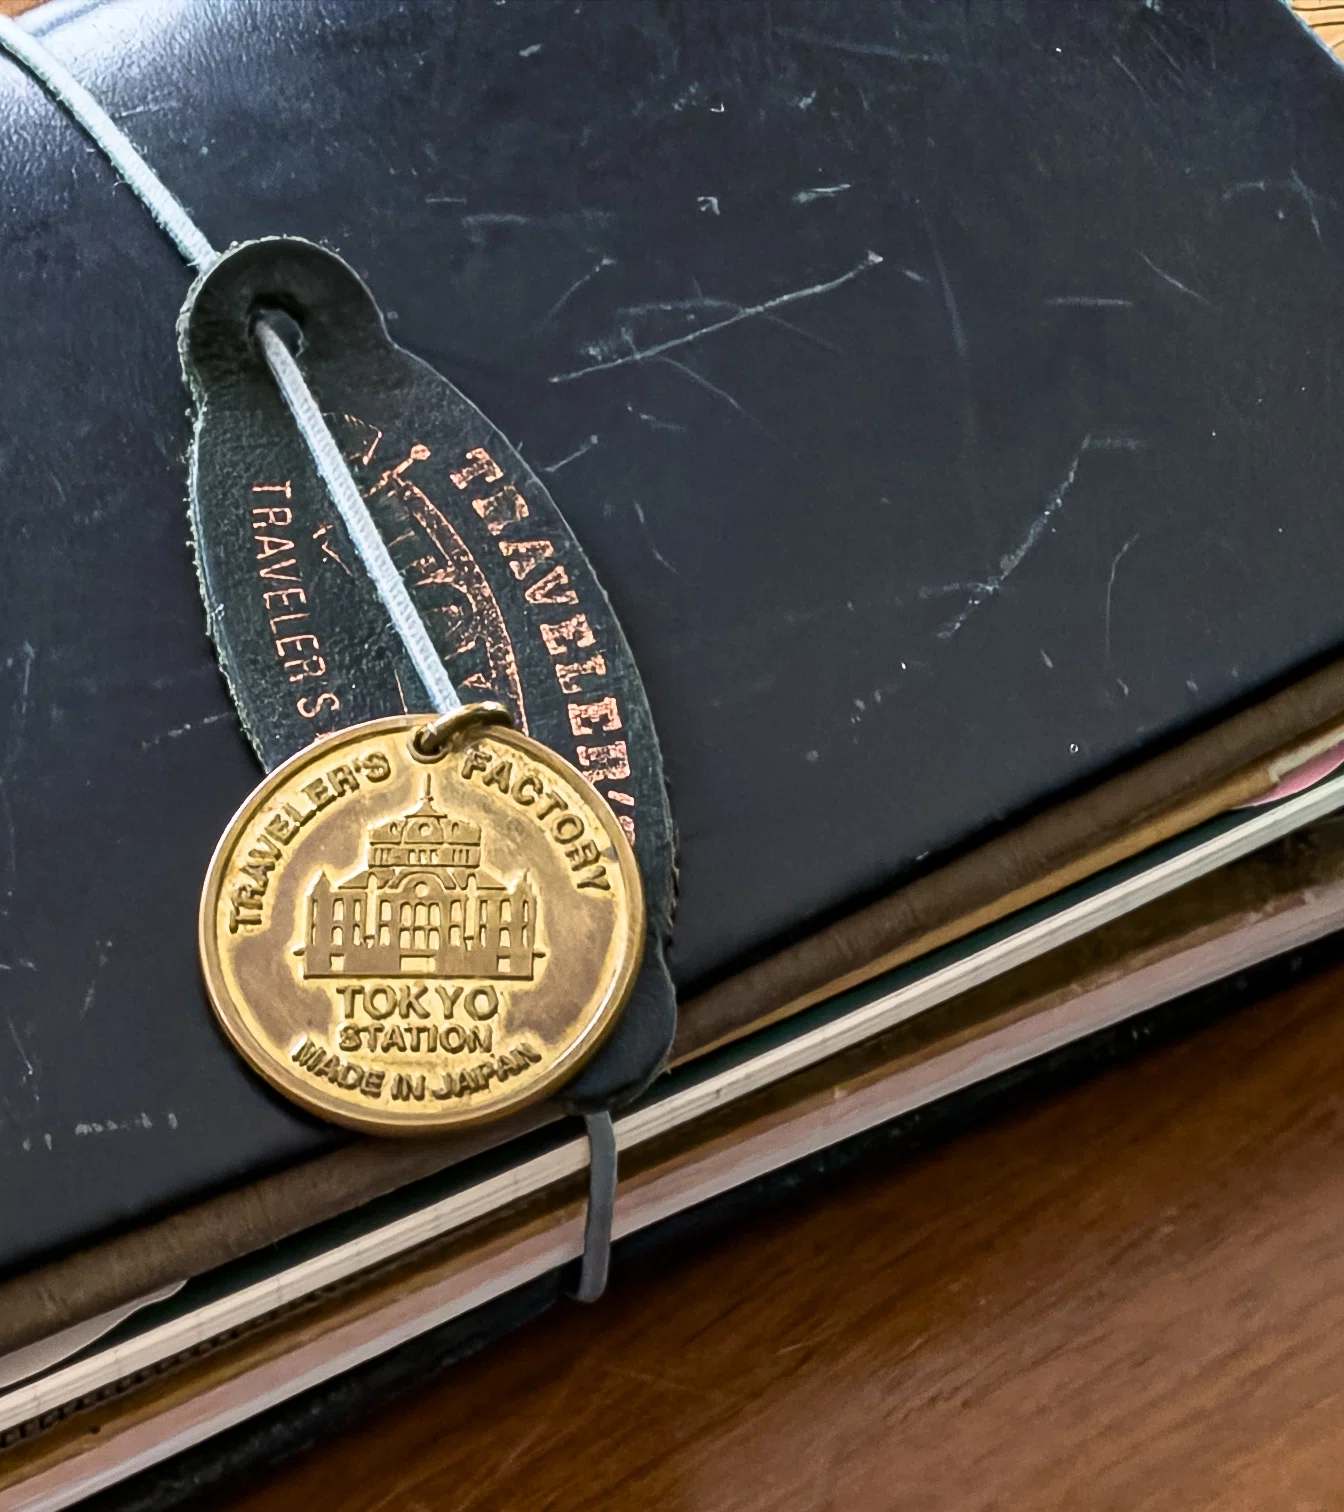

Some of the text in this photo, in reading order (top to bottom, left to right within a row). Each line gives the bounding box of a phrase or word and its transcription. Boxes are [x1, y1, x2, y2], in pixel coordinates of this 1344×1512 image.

[461, 744, 612, 895] FACTORY
[337, 984, 499, 1021] TOKYO
[338, 1023, 493, 1055] STATION
[292, 1034, 542, 1101] MADE IN JAPAN
